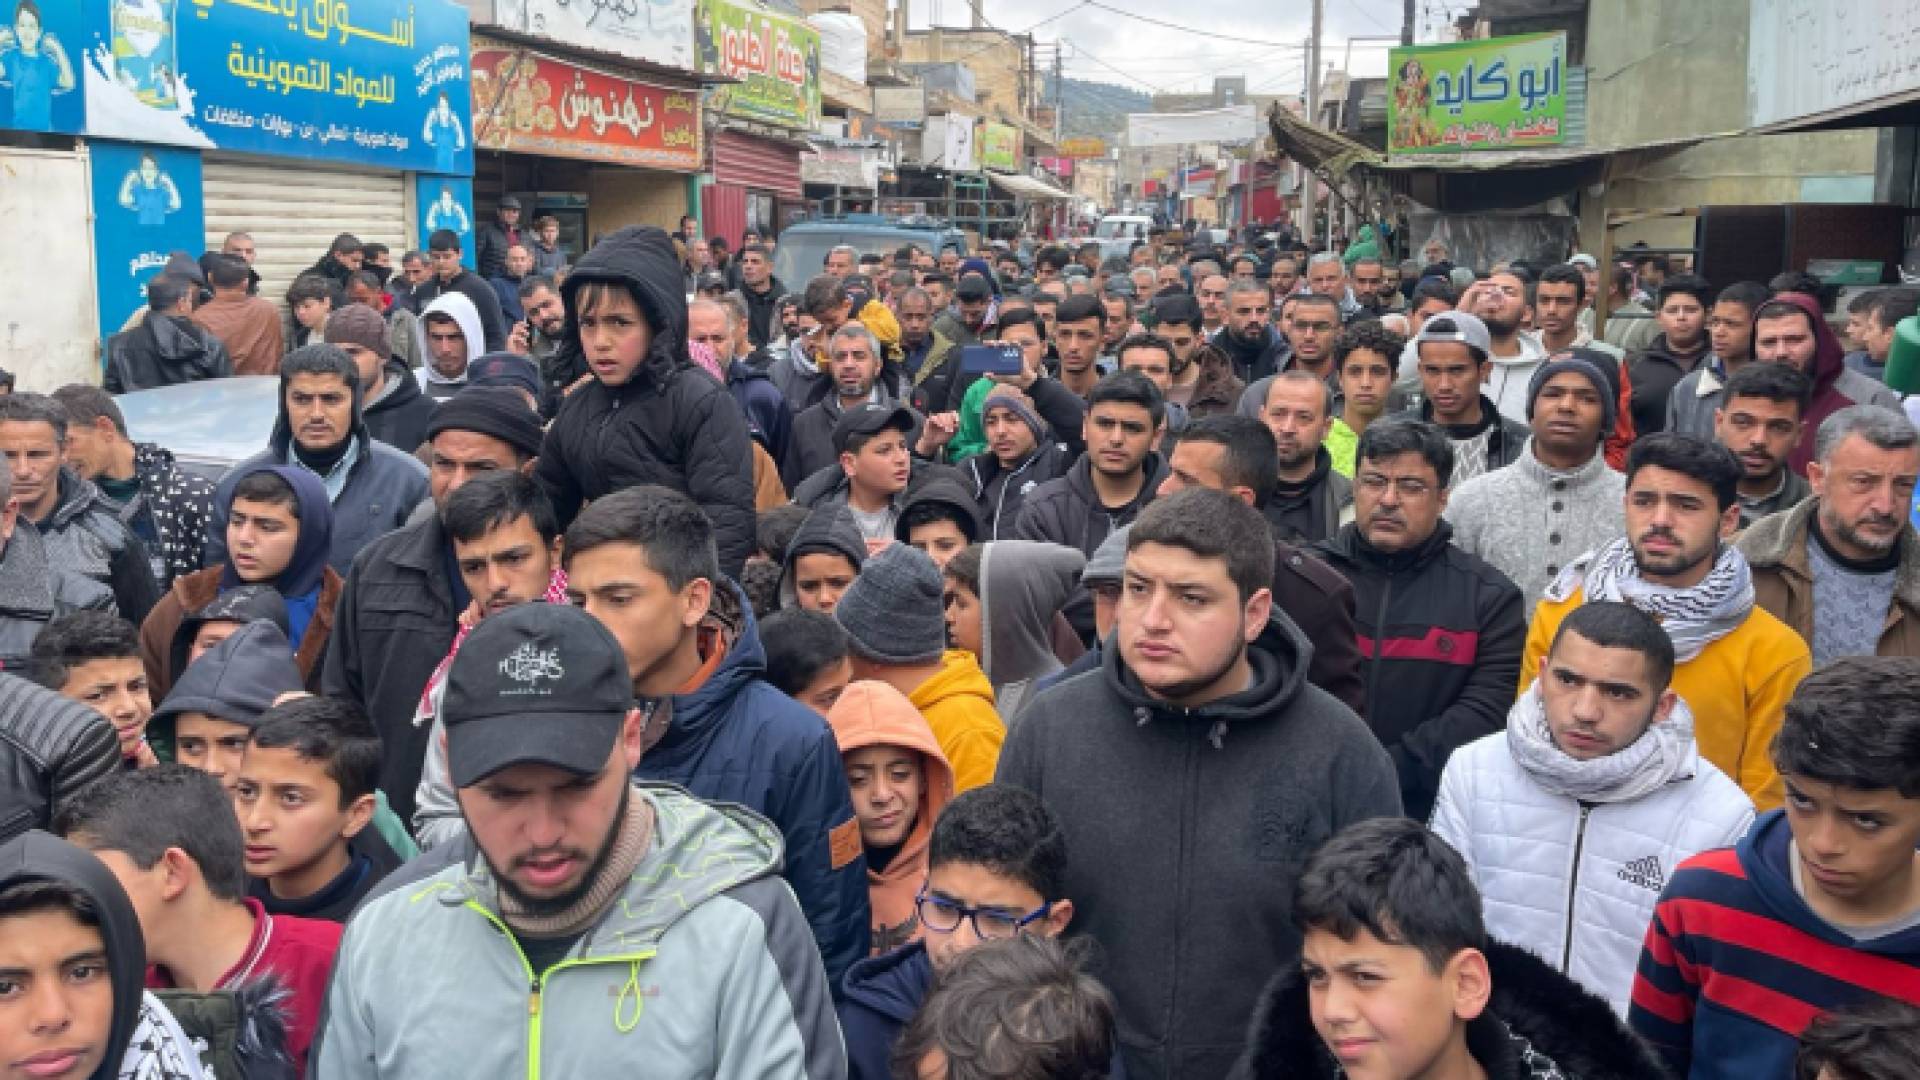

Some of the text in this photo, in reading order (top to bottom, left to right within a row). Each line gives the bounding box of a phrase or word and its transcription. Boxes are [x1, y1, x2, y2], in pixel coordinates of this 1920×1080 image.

[228, 42, 395, 109] للمواد التموينية
[560, 72, 654, 139] نهنوش
[1435, 40, 1561, 115] أبو كايد
